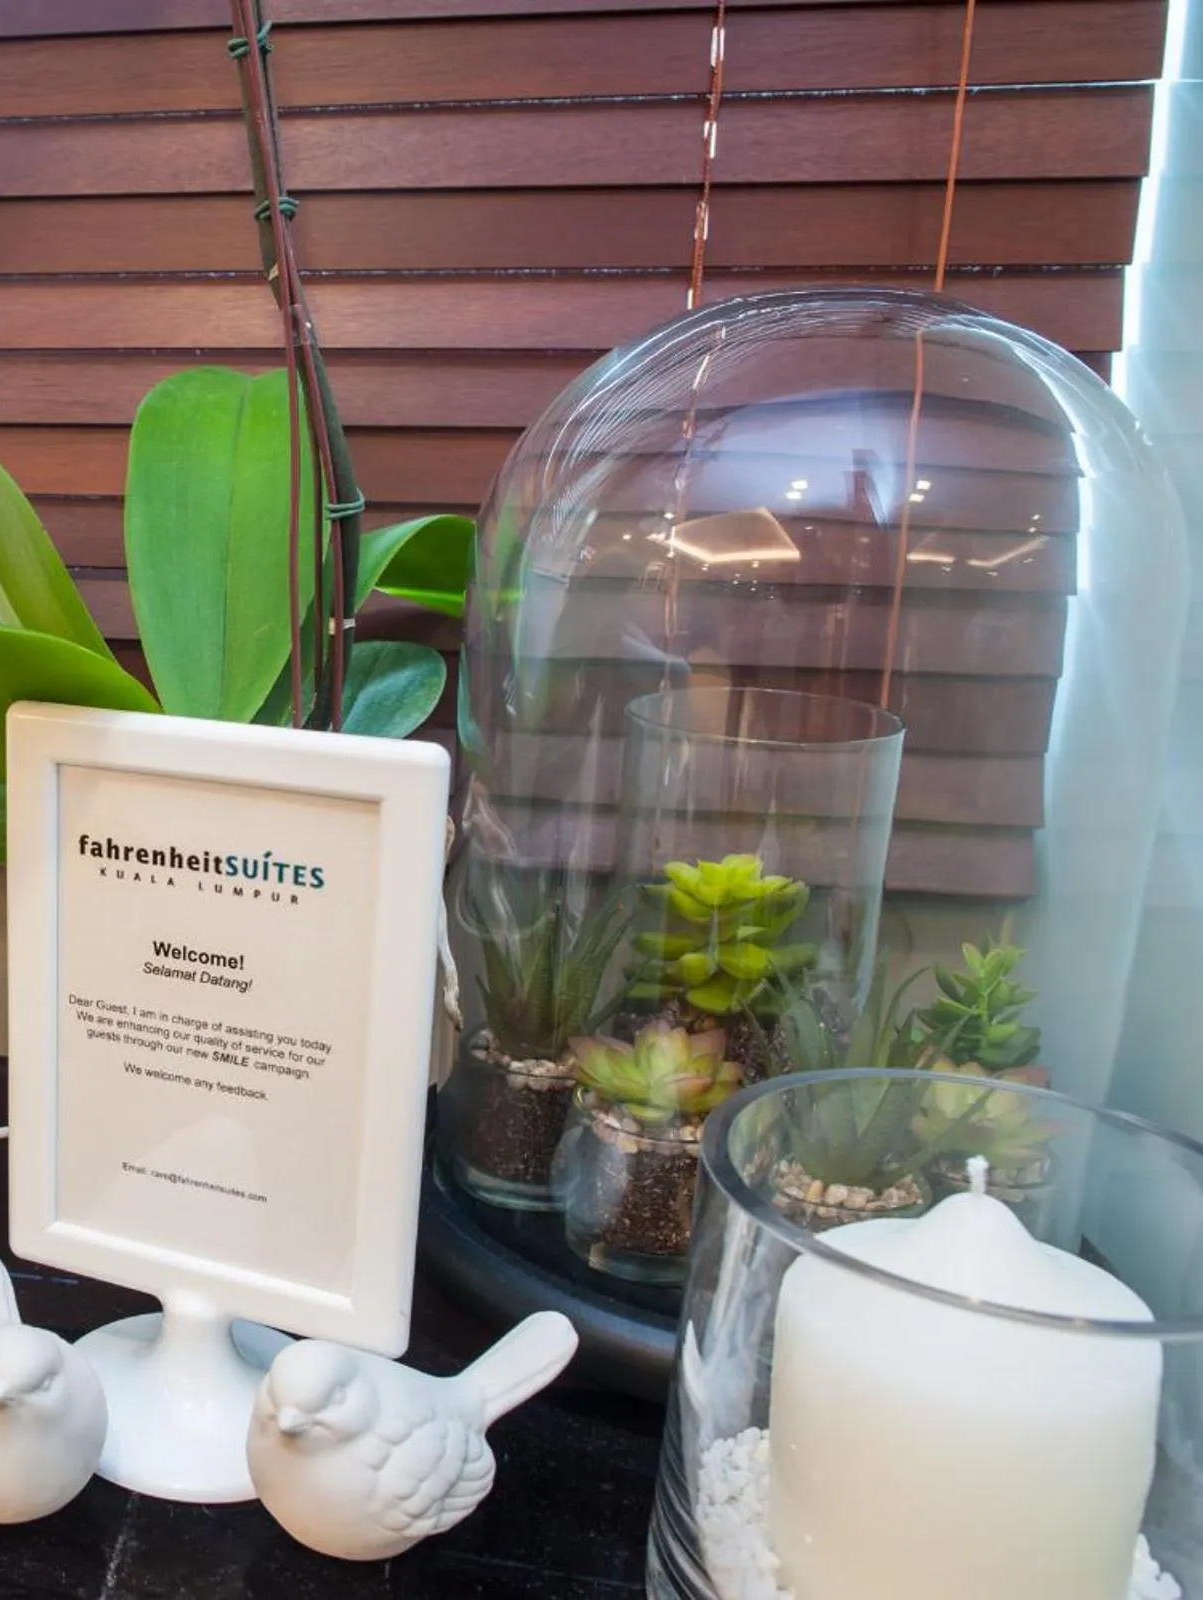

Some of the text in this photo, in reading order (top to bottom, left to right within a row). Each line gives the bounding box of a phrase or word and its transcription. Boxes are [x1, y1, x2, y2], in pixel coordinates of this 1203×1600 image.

[99, 867, 300, 905] KUALA LUMPUR
[153, 940, 244, 970] Welcome!
[142, 961, 253, 993] Selamat Datang!
[68, 994, 93, 1008] Dear
[133, 1006, 137, 1015] I
[139, 1009, 156, 1019] am
[159, 1012, 169, 1022] in
[171, 1014, 209, 1030] charge
[211, 1022, 223, 1031] of
[225, 1025, 274, 1044] assisting
[276, 1034, 298, 1046] you
[77, 1010, 326, 1066] We are enhancing our quality of service for our
[86, 1028, 121, 1042] guests
[123, 1033, 163, 1051] through
[165, 1043, 184, 1055] our
[186, 1047, 209, 1060] new
[212, 1050, 251, 1068] SMILE
[123, 1061, 143, 1075] We
[144, 1067, 193, 1085] welcome
[194, 1077, 214, 1092] any
